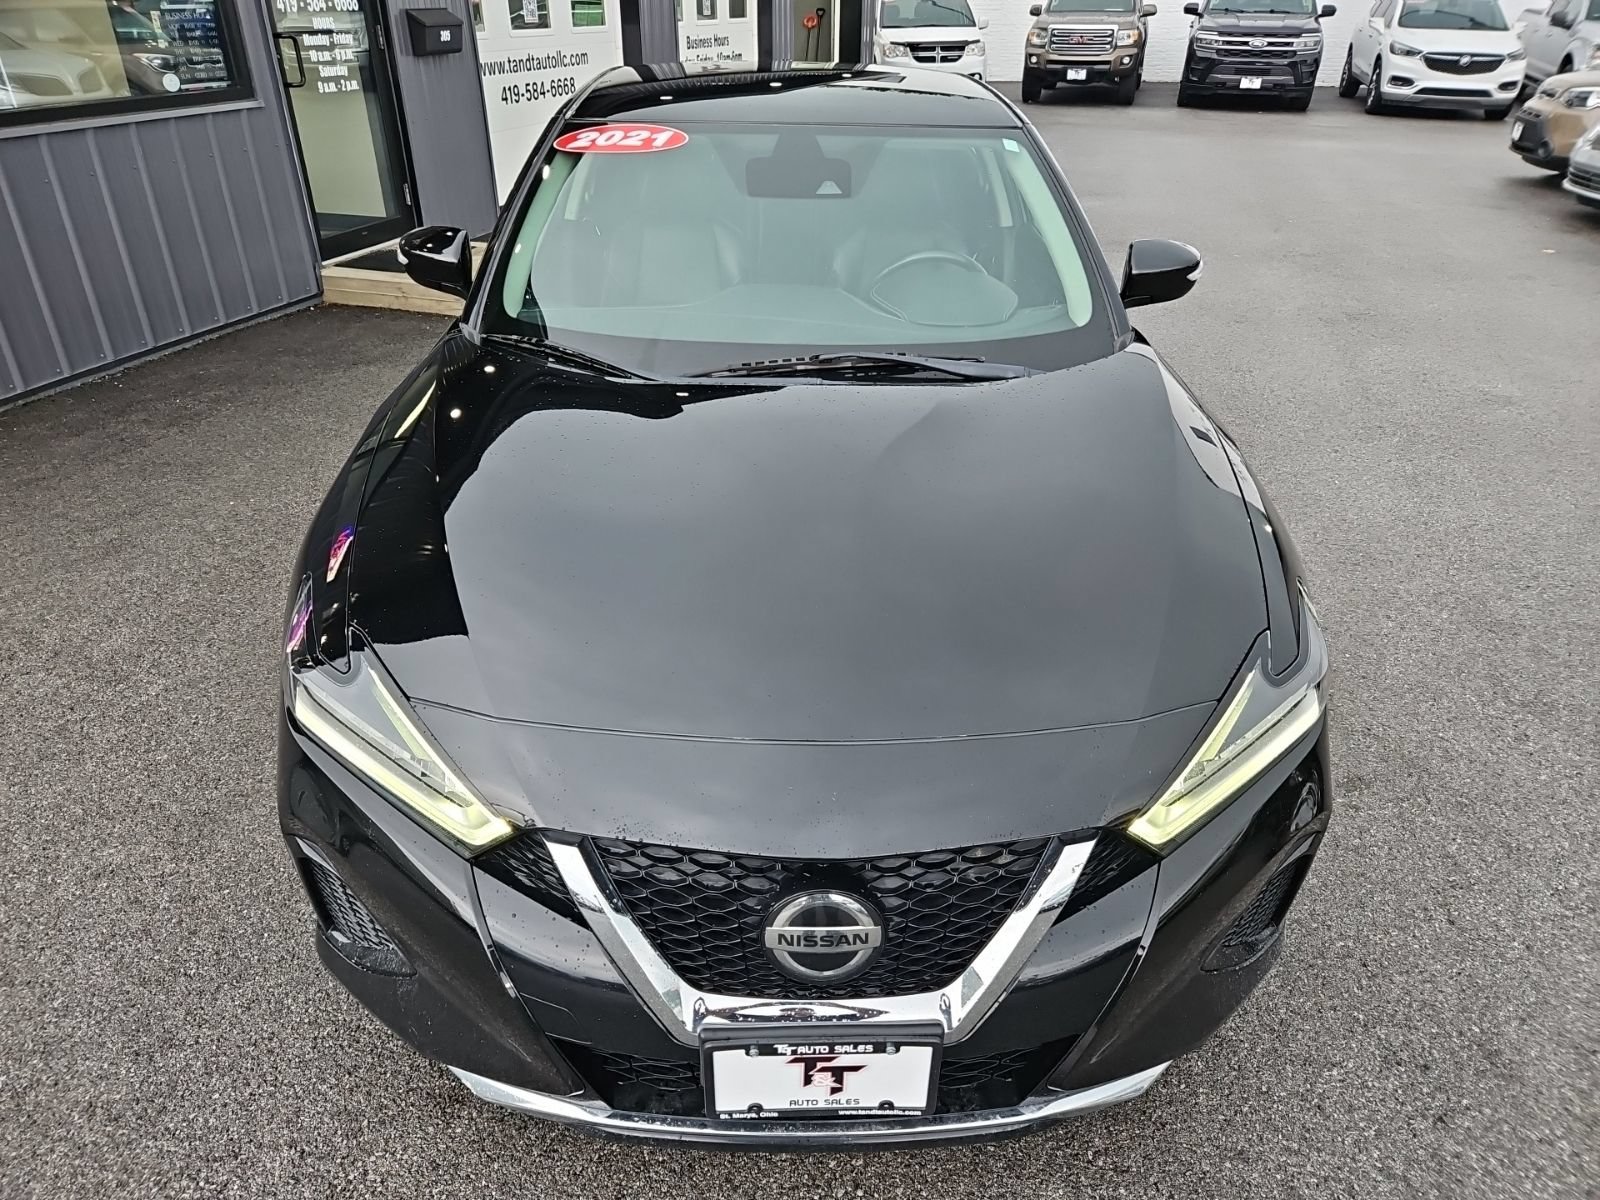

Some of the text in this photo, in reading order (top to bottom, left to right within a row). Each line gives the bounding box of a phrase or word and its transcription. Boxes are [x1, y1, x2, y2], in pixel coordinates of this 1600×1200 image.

[312, 17, 335, 29] HOURS
[302, 33, 330, 47] Monday
[333, 32, 353, 46] Friday
[440, 30, 451, 41] 305
[686, 32, 730, 50] Business Hours
[319, 64, 348, 77] Saturday
[318, 81, 324, 94] 9
[341, 80, 347, 91] 2
[501, 76, 577, 105] 419-584-6668
[565, 130, 675, 149] 2021
[777, 932, 869, 947] NISSAN
[797, 1045, 830, 1054] AUTO
[834, 1044, 874, 1053] SALES
[789, 1098, 860, 1107] AUTO SALES
